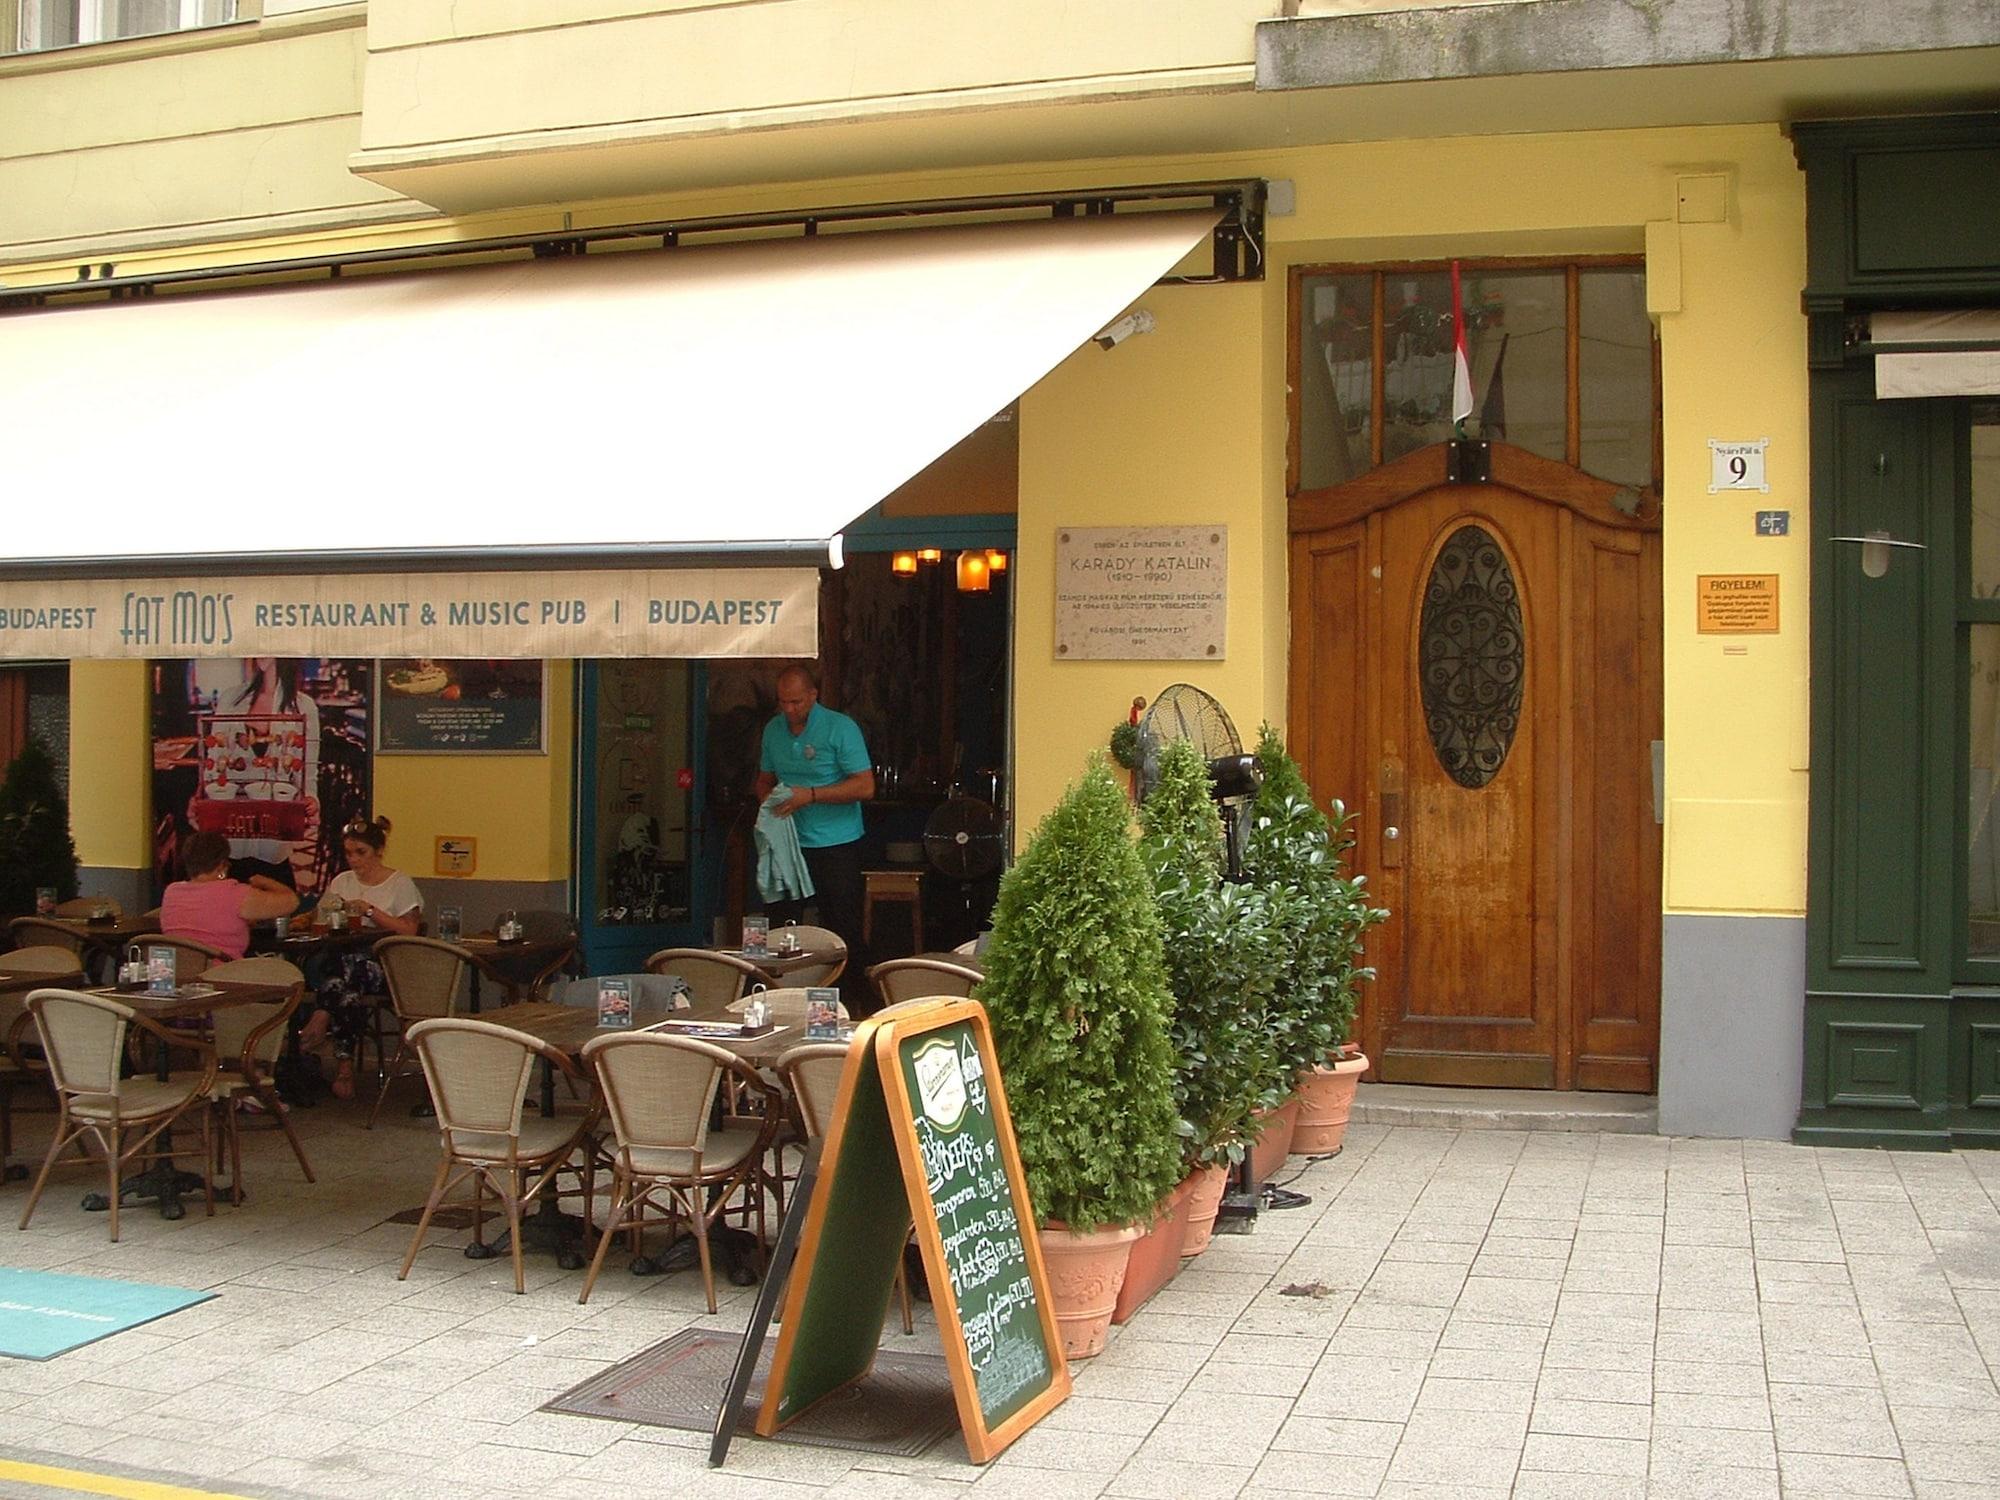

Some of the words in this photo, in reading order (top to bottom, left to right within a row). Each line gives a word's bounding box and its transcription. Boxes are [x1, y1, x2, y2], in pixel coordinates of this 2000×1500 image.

[1729, 456, 1747, 484] 9
[1144, 556, 1212, 569] KATALIN
[1711, 580, 1765, 590] FIGYELEM!
[0, 608, 96, 629] BUDAPEST
[256, 603, 410, 626] RESTAURANT
[420, 603, 437, 626] &
[449, 601, 529, 626] MUSIC
[541, 600, 587, 625] PUB
[648, 599, 783, 625] BUDAPEST
